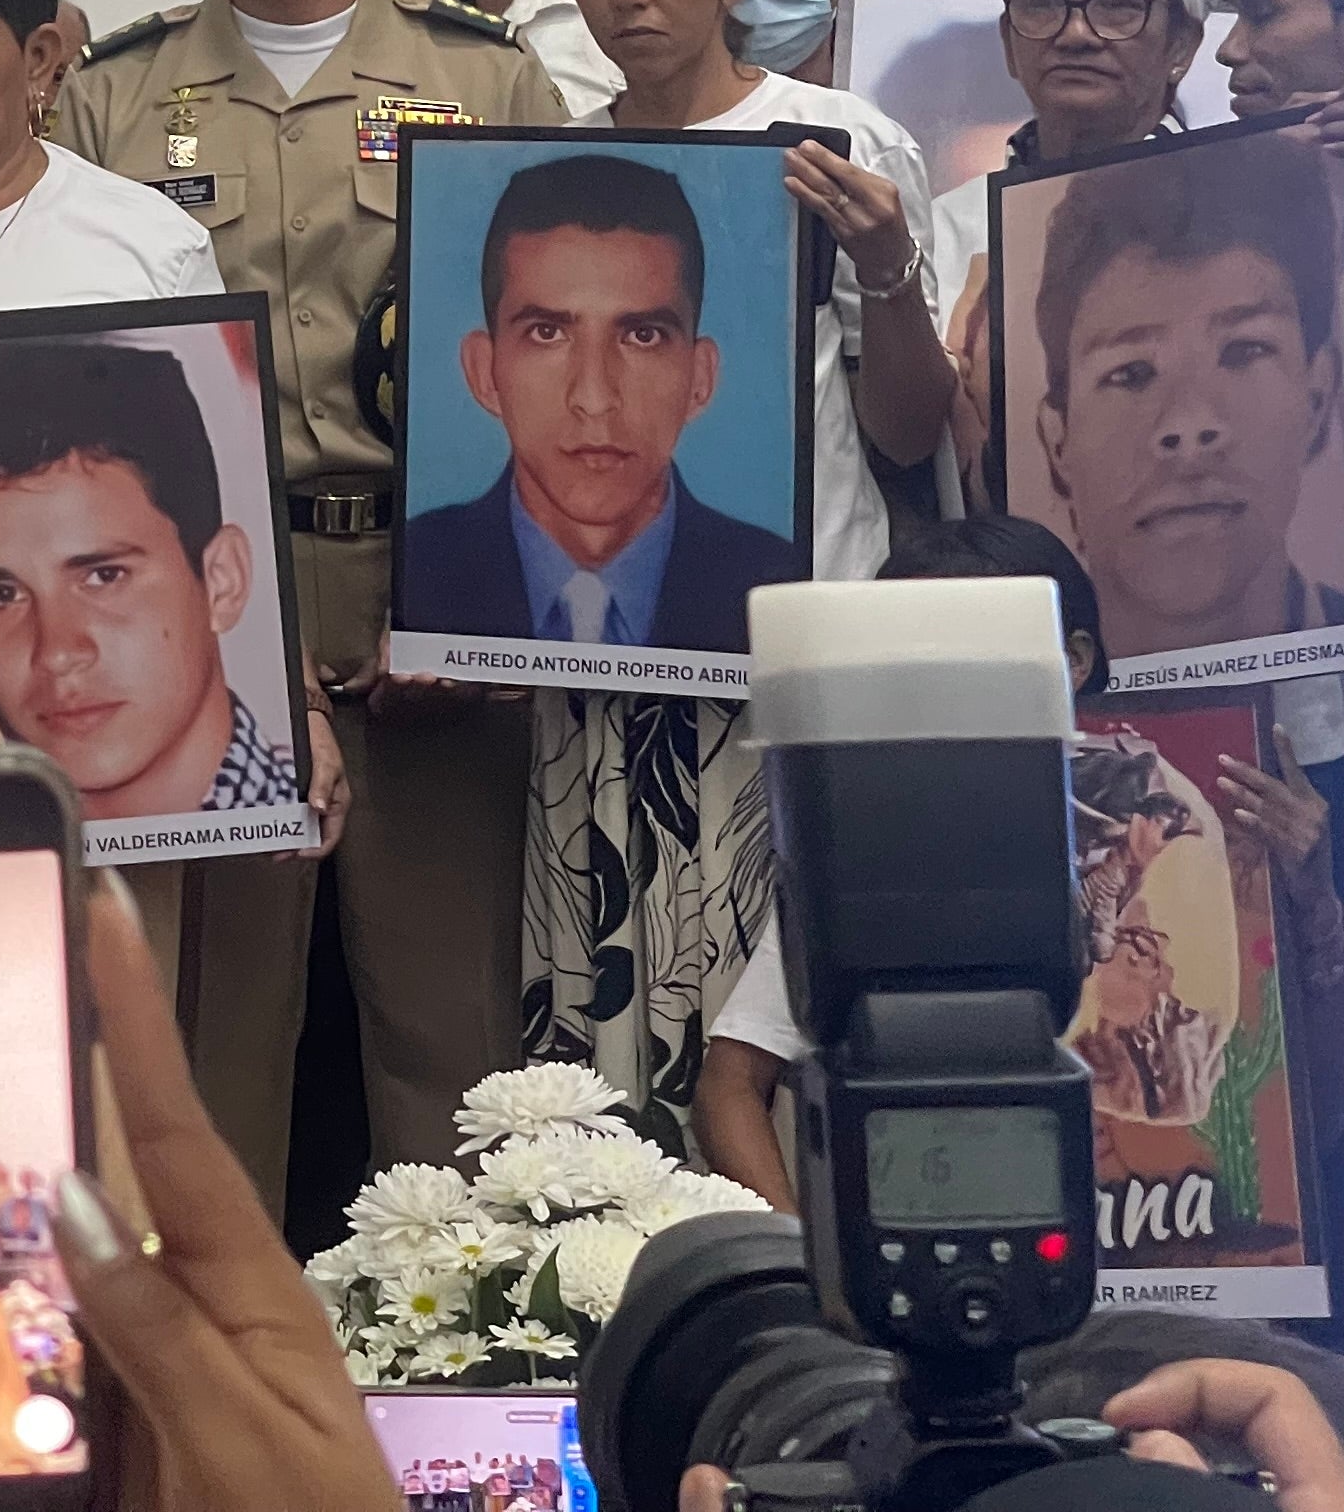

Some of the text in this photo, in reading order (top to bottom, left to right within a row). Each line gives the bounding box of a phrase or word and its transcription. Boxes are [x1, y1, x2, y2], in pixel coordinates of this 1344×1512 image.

[444, 649, 749, 686] ALFREDO ANTONIO ROPERO ABRIL
[1125, 664, 1178, 689] JESÚS
[1182, 654, 1258, 681] ALVAREZ
[1263, 643, 1344, 668] LEDESMA
[96, 828, 225, 852] VALDERRAMA
[230, 820, 304, 840] RUIDÍAZ
[1123, 1285, 1218, 1302] RAMIREZ
